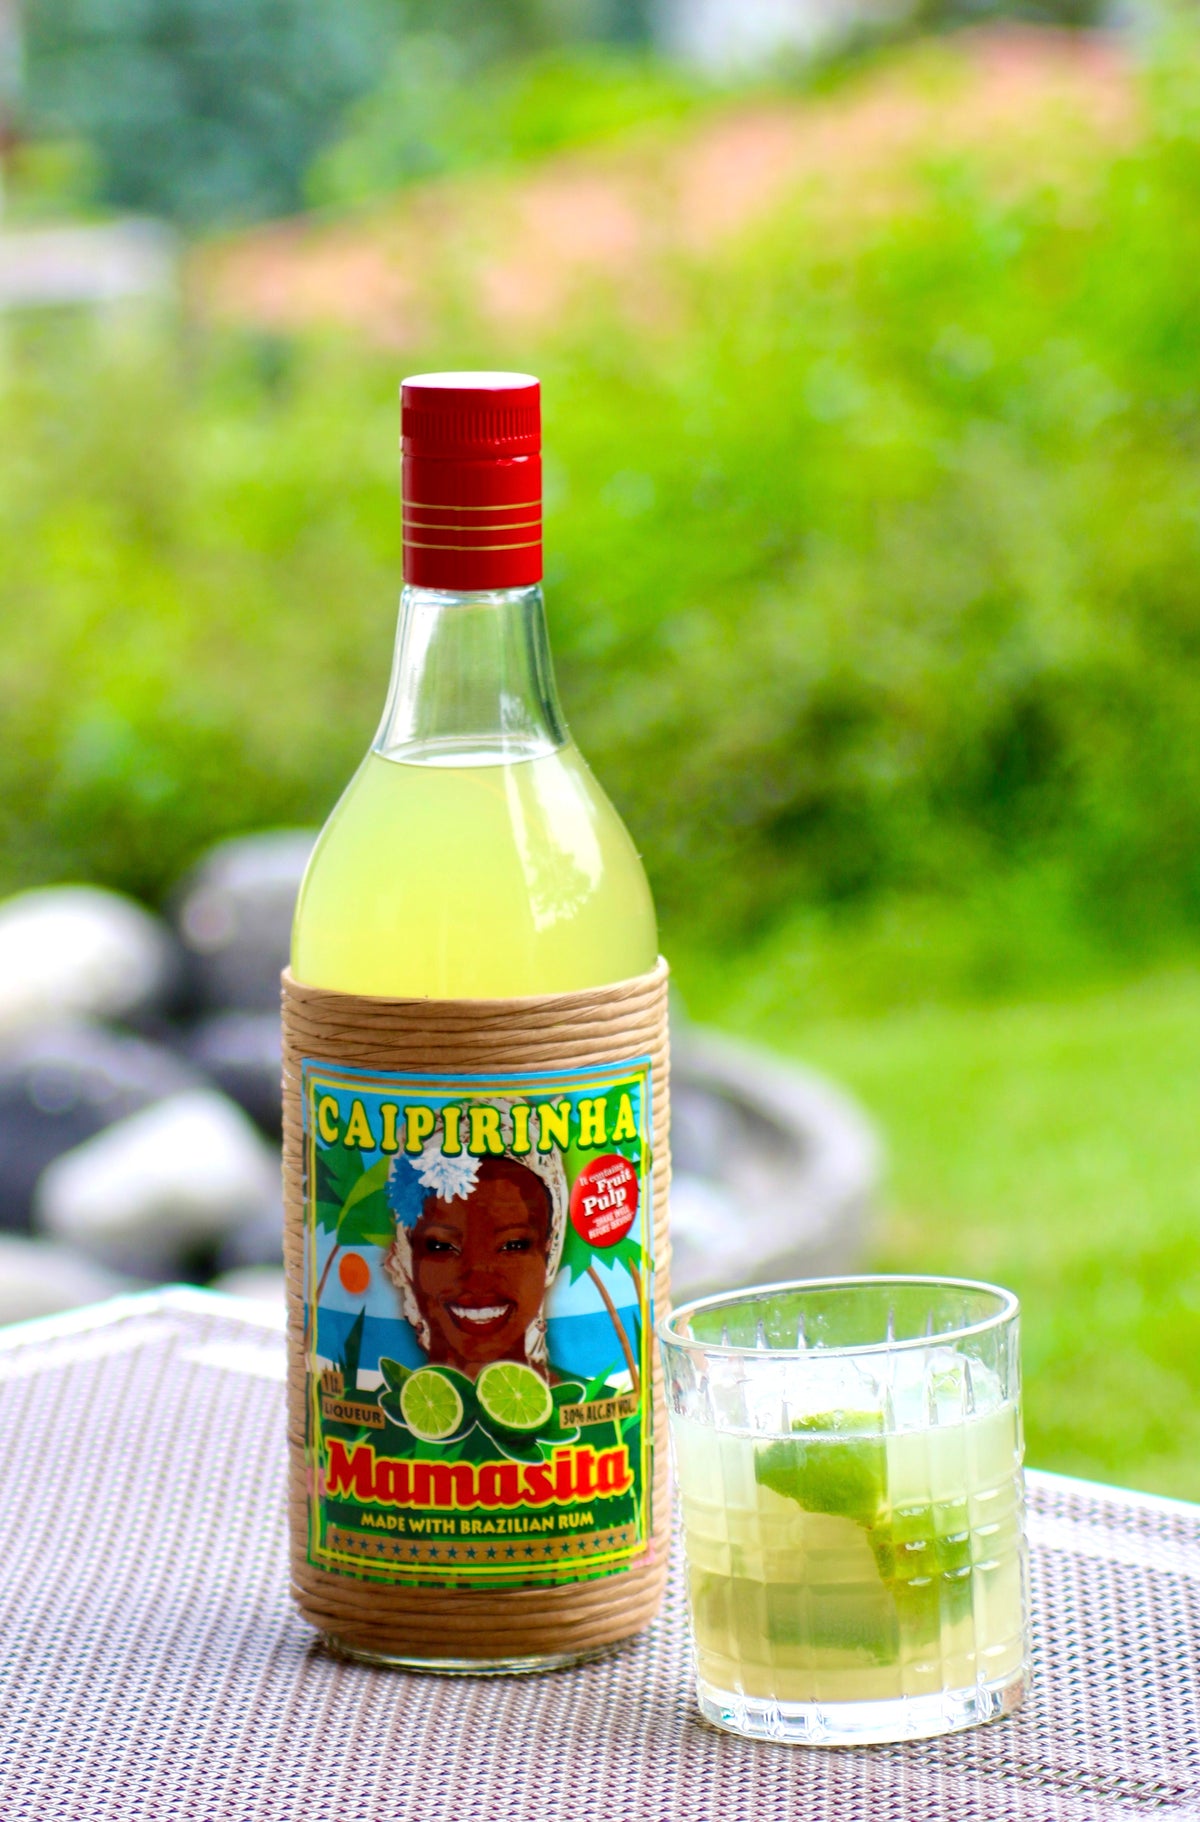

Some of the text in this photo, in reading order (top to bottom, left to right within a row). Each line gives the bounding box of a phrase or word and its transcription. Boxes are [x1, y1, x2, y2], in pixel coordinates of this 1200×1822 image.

[317, 1093, 638, 1154] CAIPIRINHA
[589, 1163, 625, 1182] contains
[596, 1168, 632, 1194] Fruit
[582, 1187, 627, 1217] Pulp
[325, 1402, 382, 1424] LIQUEUR
[563, 1407, 585, 1426] 30%
[617, 1398, 636, 1417] VOL.
[325, 1437, 634, 1510] Mamasita
[360, 1511, 594, 1534] MADE WITH BRAZILIAN RUM
